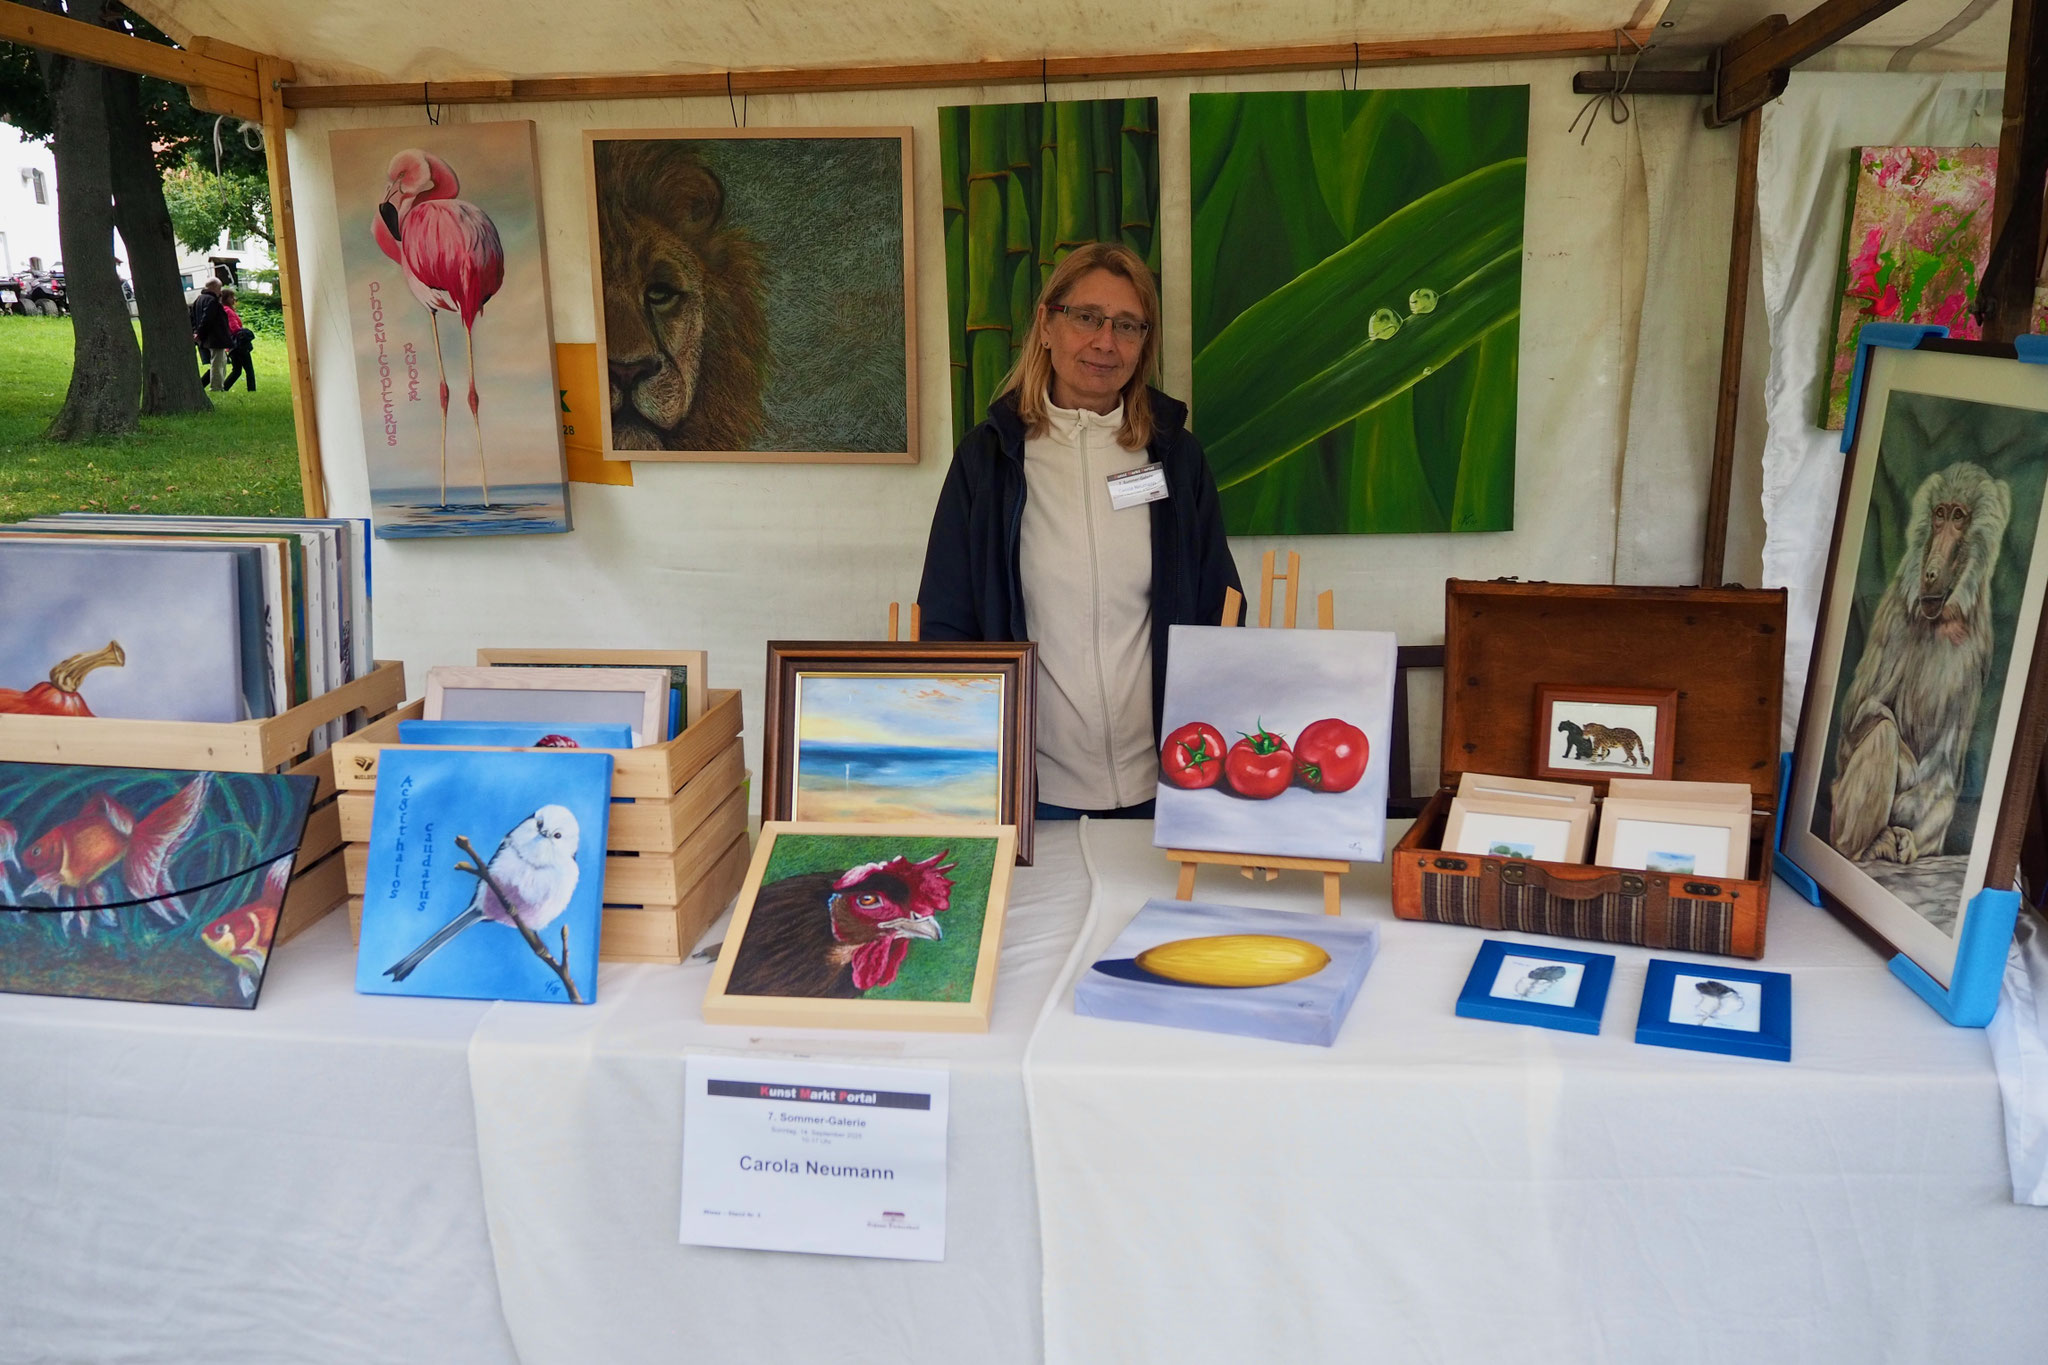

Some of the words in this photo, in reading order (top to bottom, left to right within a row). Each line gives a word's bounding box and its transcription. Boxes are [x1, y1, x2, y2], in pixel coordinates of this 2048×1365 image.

[760, 1085, 797, 1099] Kunst
[800, 1087, 836, 1102] Markt
[839, 1090, 877, 1105] Portal
[780, 1112, 867, 1128] Sommer-Galerie
[739, 1155, 800, 1174] Carola
[806, 1160, 895, 1180] Neumann
